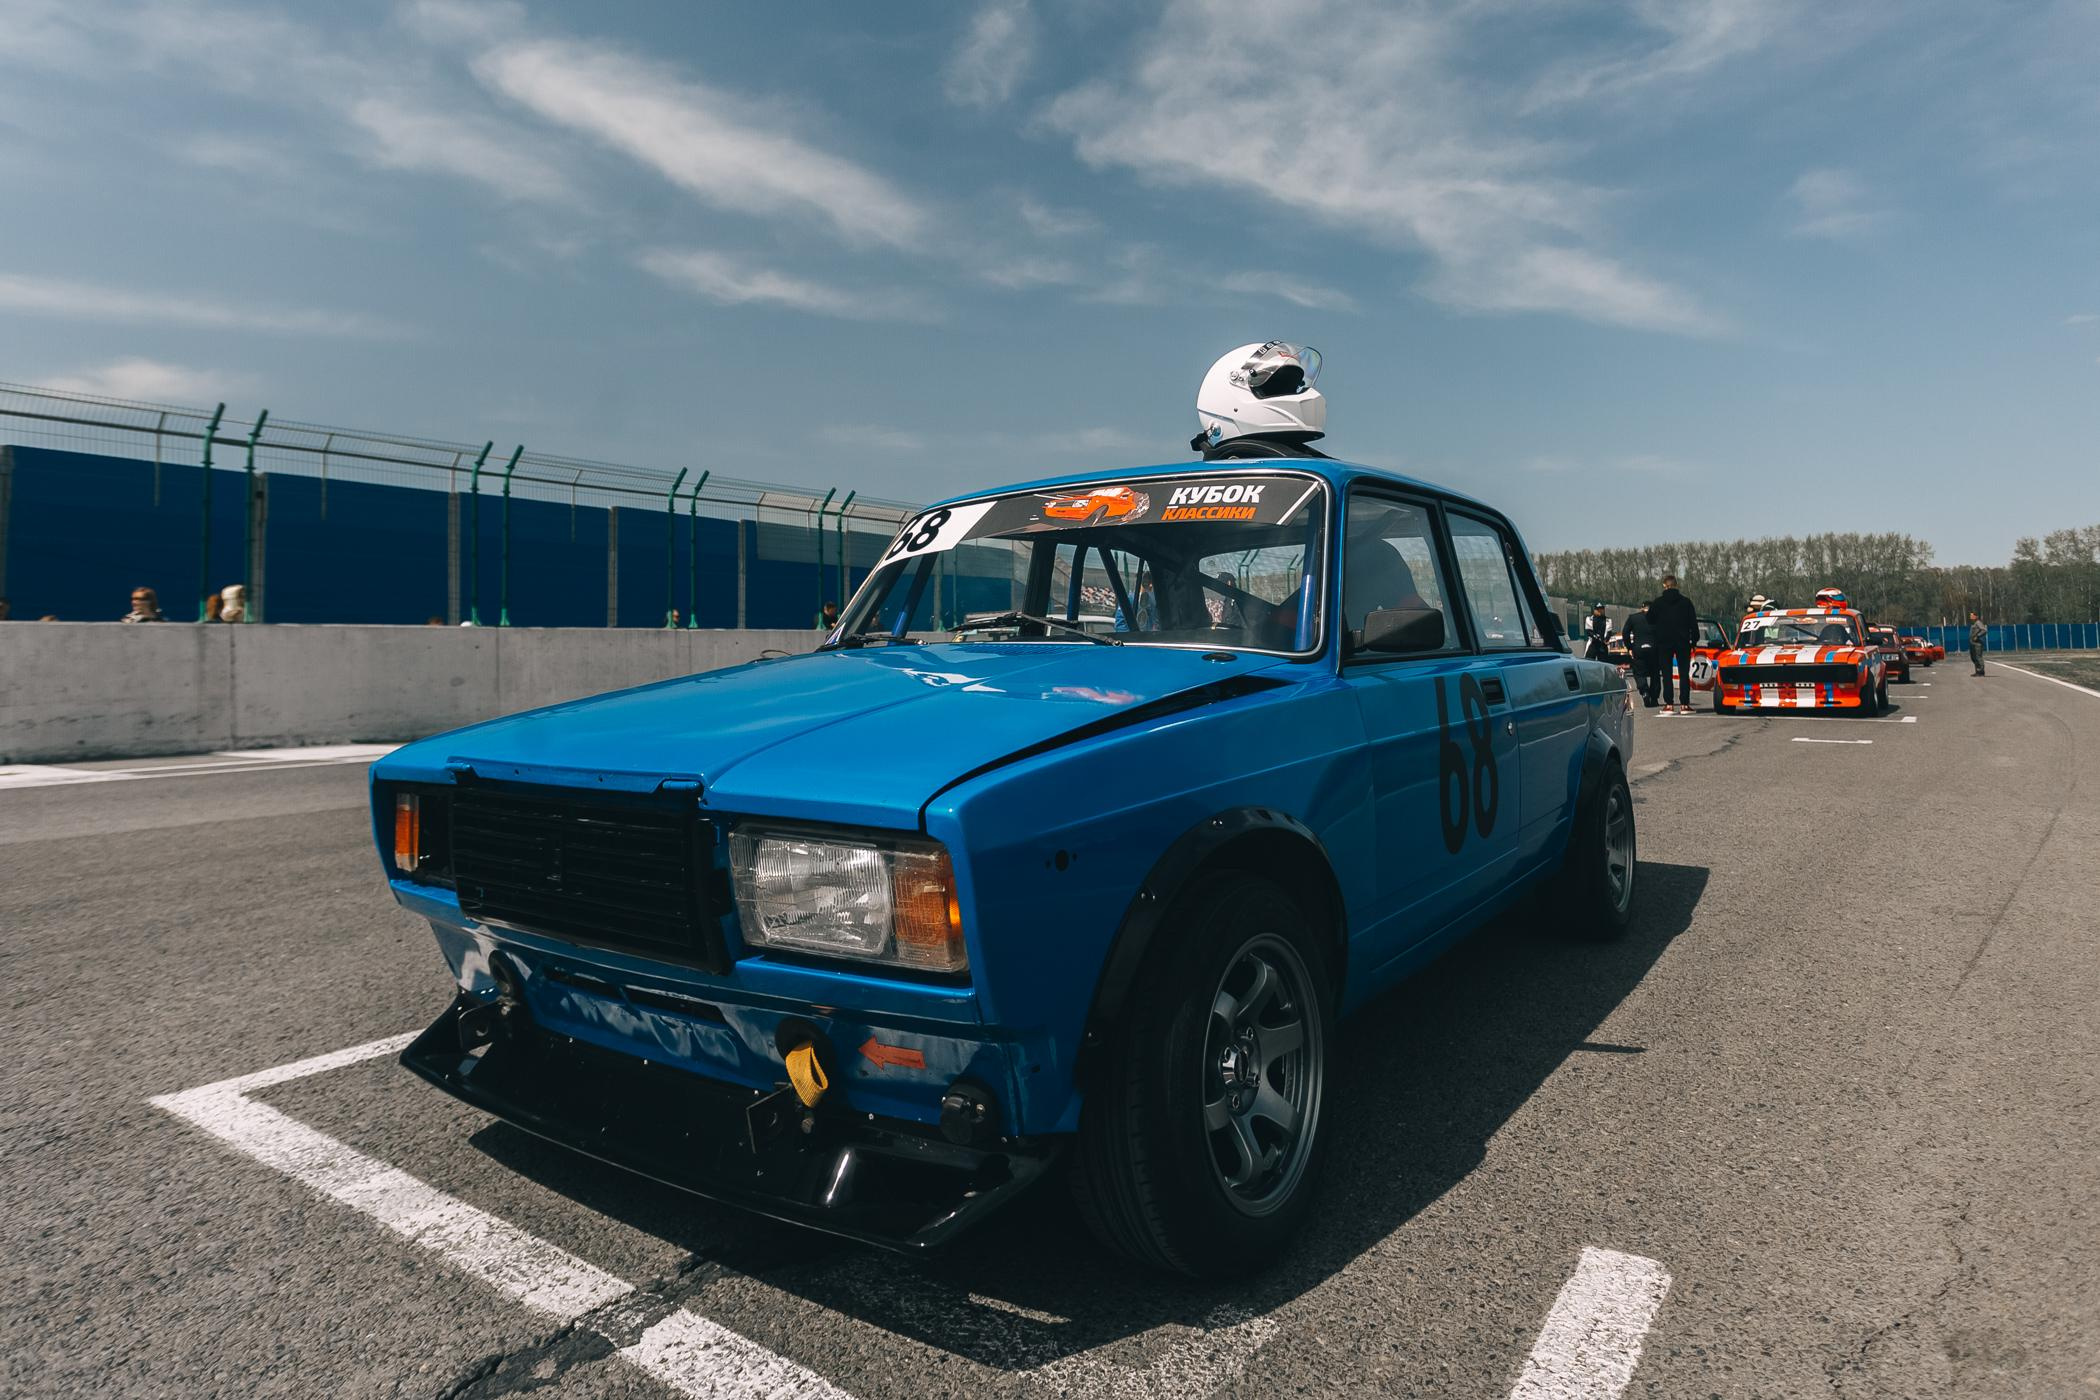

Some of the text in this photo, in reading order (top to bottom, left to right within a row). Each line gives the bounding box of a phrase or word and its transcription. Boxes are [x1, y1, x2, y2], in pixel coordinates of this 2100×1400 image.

[1168, 485, 1265, 505] КУБОК
[1161, 507, 1257, 520] КЛАССИКИ
[885, 509, 952, 560] 68
[1743, 620, 1760, 630] 27
[1691, 661, 1709, 679] 27
[1434, 672, 1498, 855] 68
